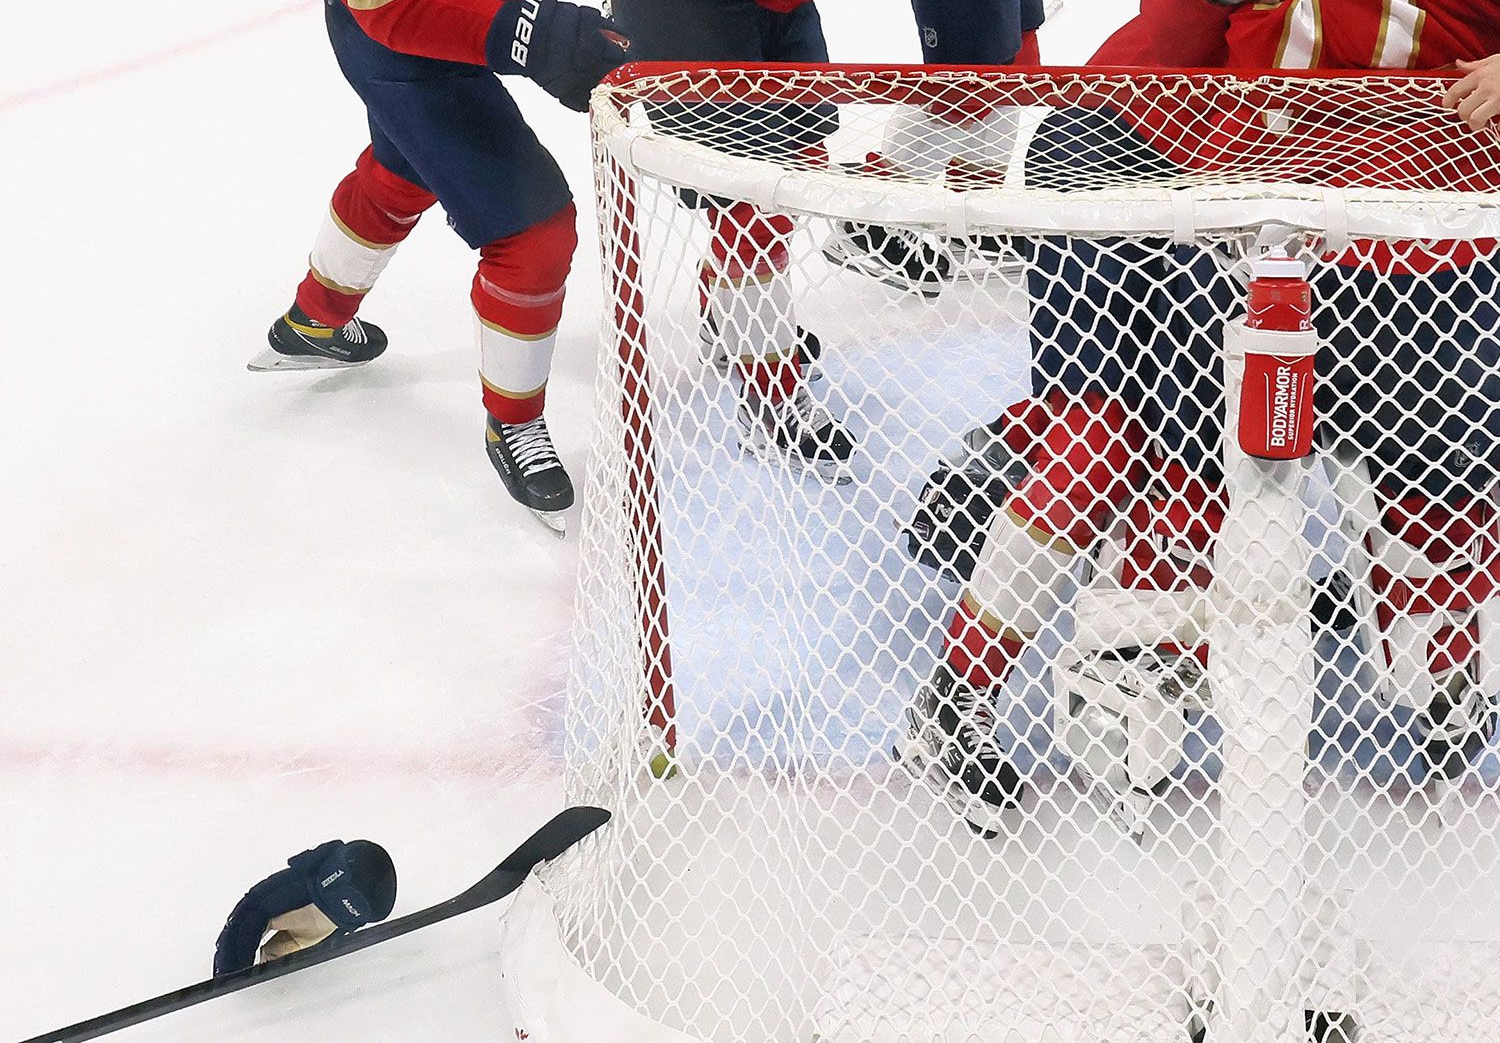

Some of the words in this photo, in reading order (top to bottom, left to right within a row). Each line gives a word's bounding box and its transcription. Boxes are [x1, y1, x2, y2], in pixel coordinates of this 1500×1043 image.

[1271, 366, 1291, 448] BODYARMOR
[1290, 372, 1299, 408] HYDRATION
[1287, 410, 1296, 441] SUPERIOR
